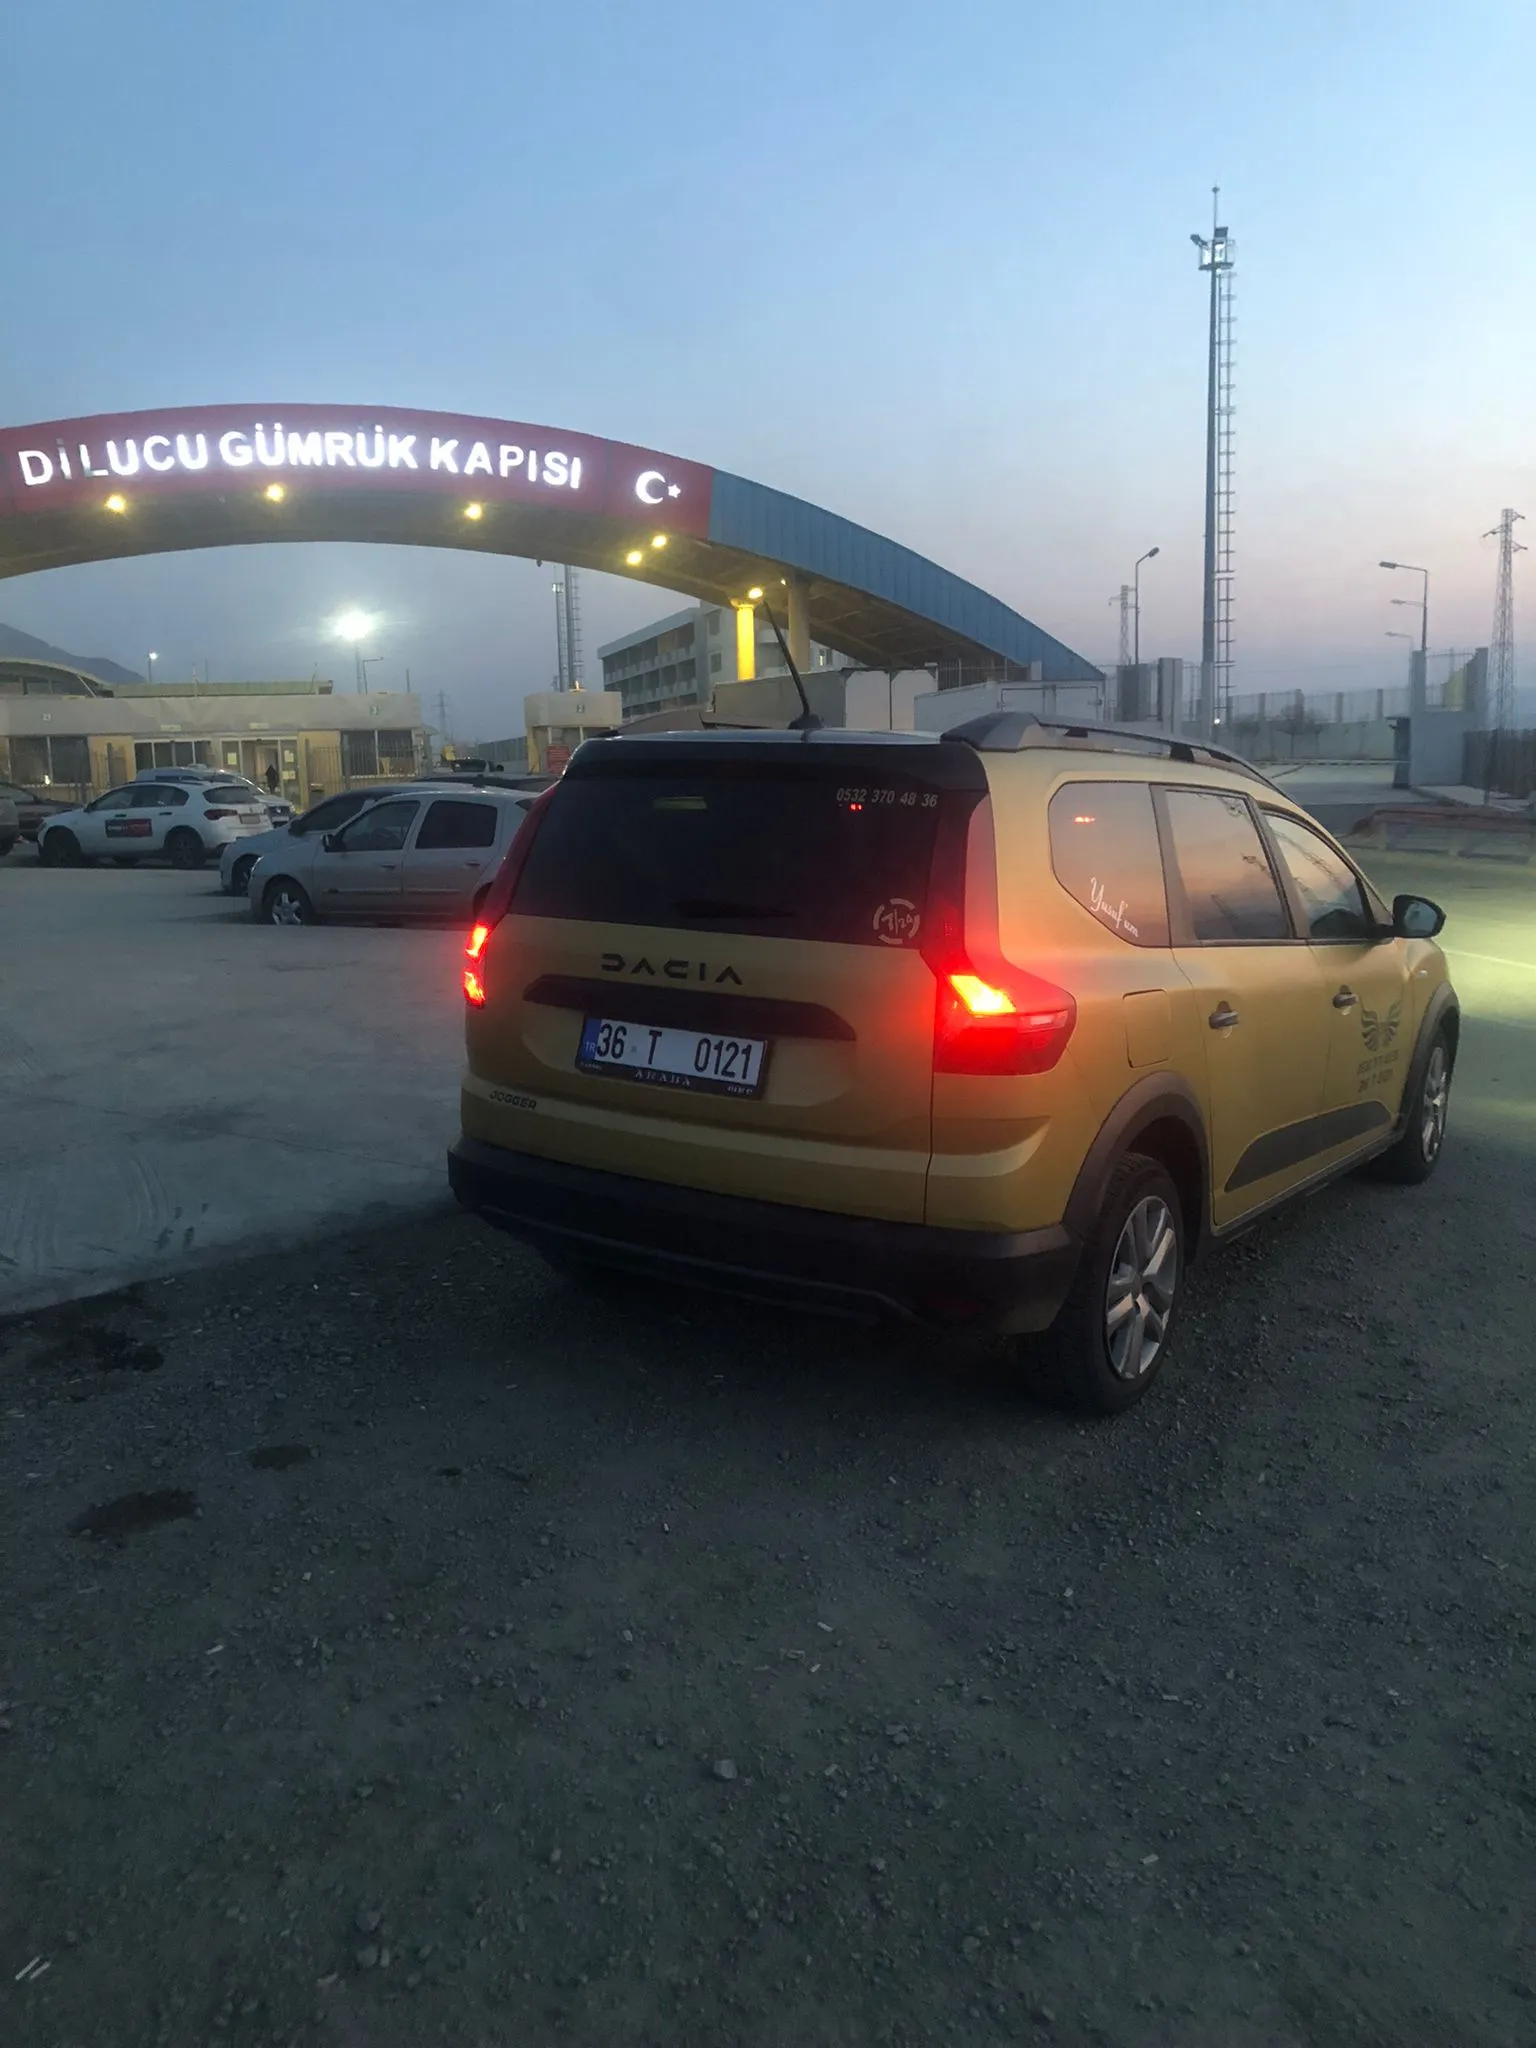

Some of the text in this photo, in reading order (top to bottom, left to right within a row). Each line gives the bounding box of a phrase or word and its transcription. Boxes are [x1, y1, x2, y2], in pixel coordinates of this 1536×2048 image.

[18, 422, 582, 489] DİLUCU GÜMRÜK KAPISI
[836, 788, 938, 808] 0532 370 48 36
[601, 953, 743, 986] DACIA
[597, 1023, 753, 1080] 36 T 0121
